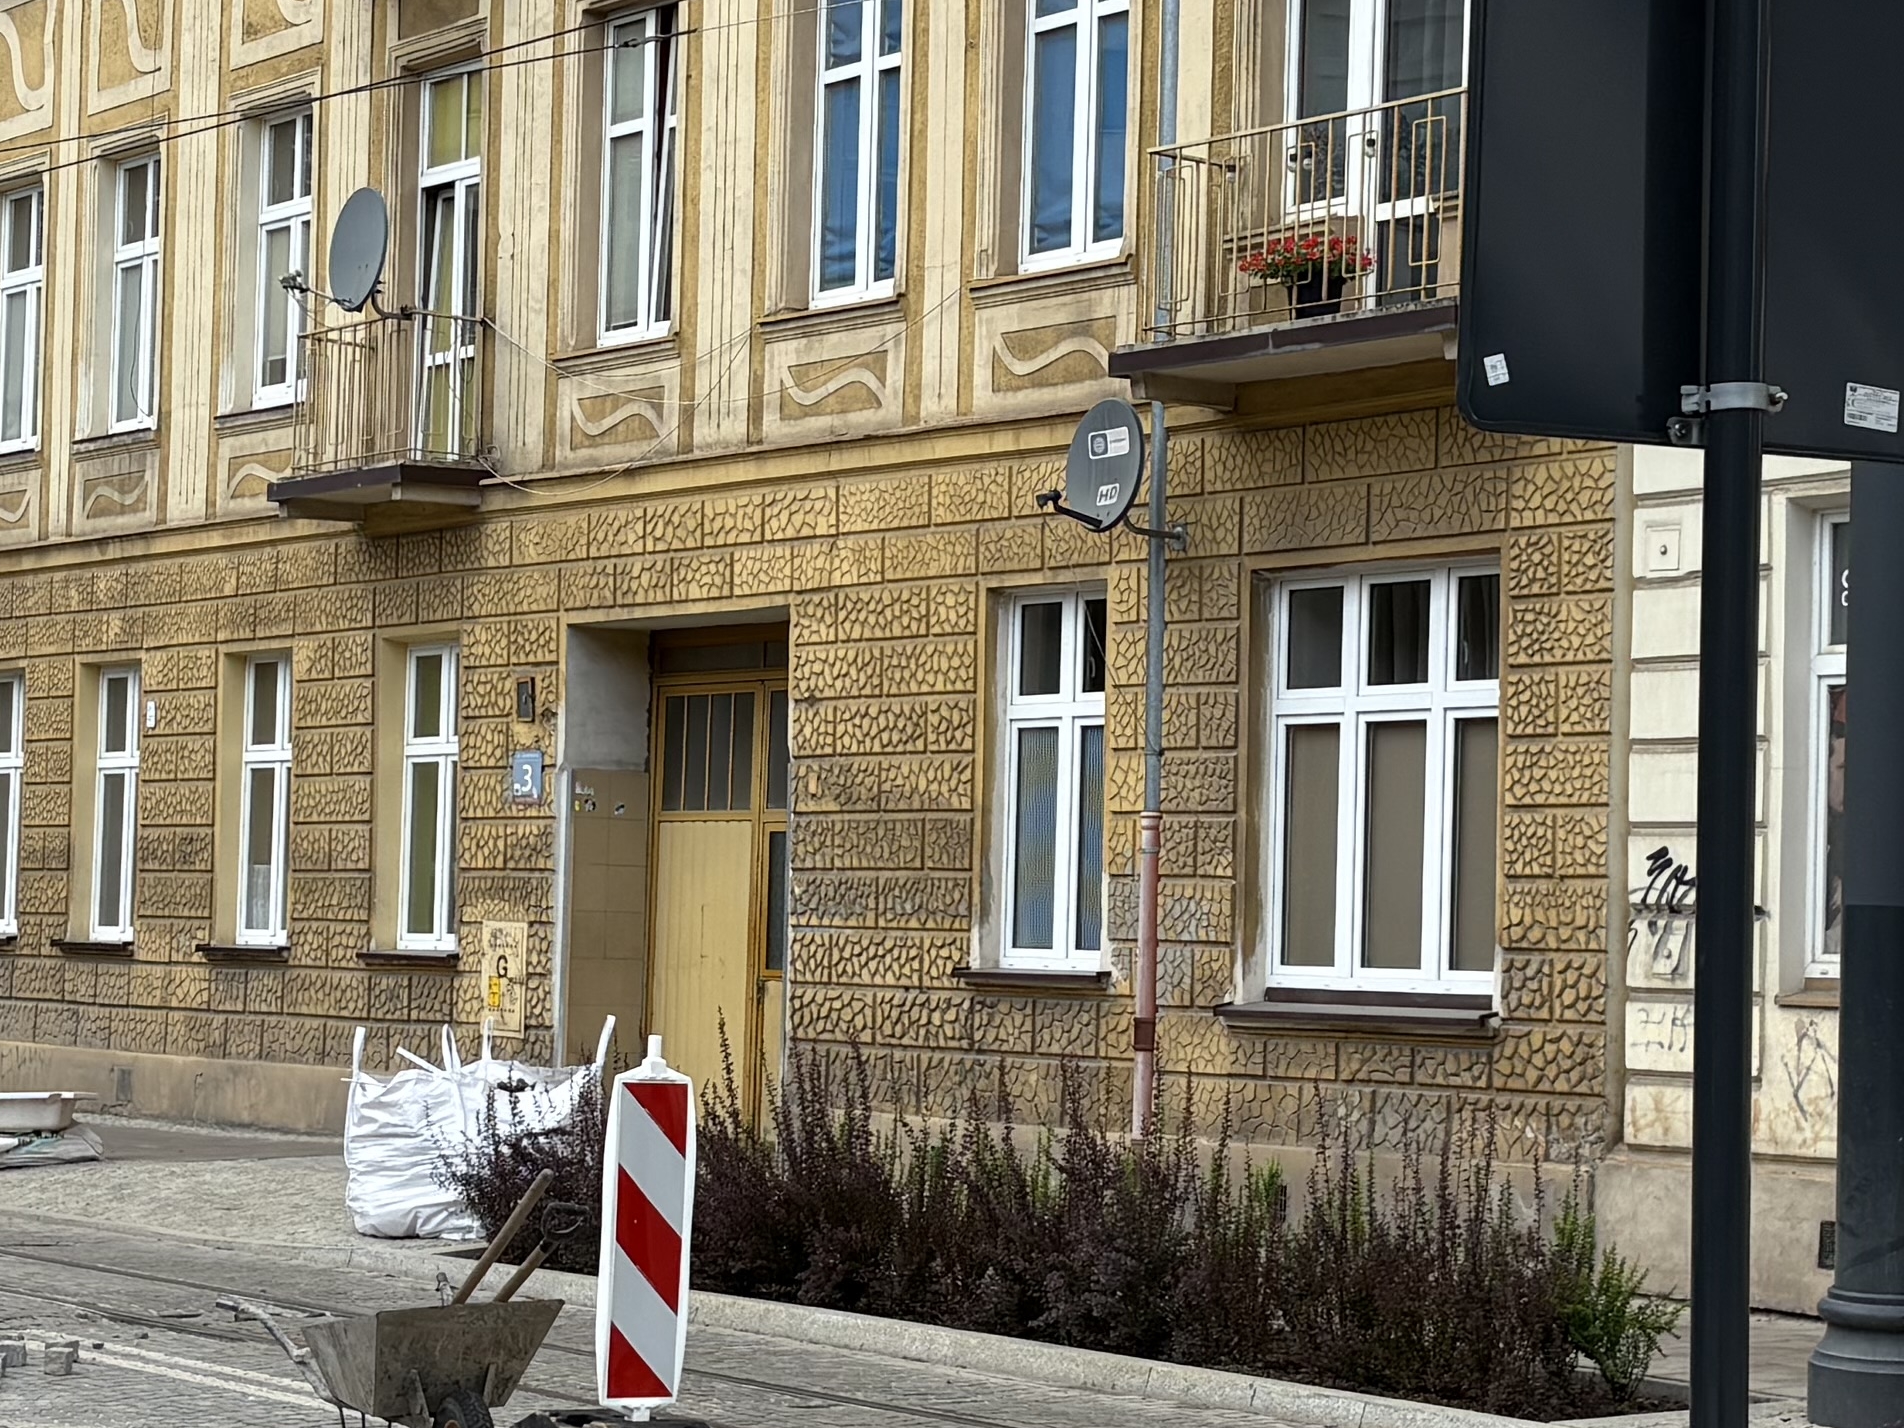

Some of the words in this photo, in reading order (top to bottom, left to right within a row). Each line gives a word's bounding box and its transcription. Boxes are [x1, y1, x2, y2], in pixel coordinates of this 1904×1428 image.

[1098, 486, 1118, 503] HD
[521, 764, 533, 792] 3
[496, 954, 508, 978] G
